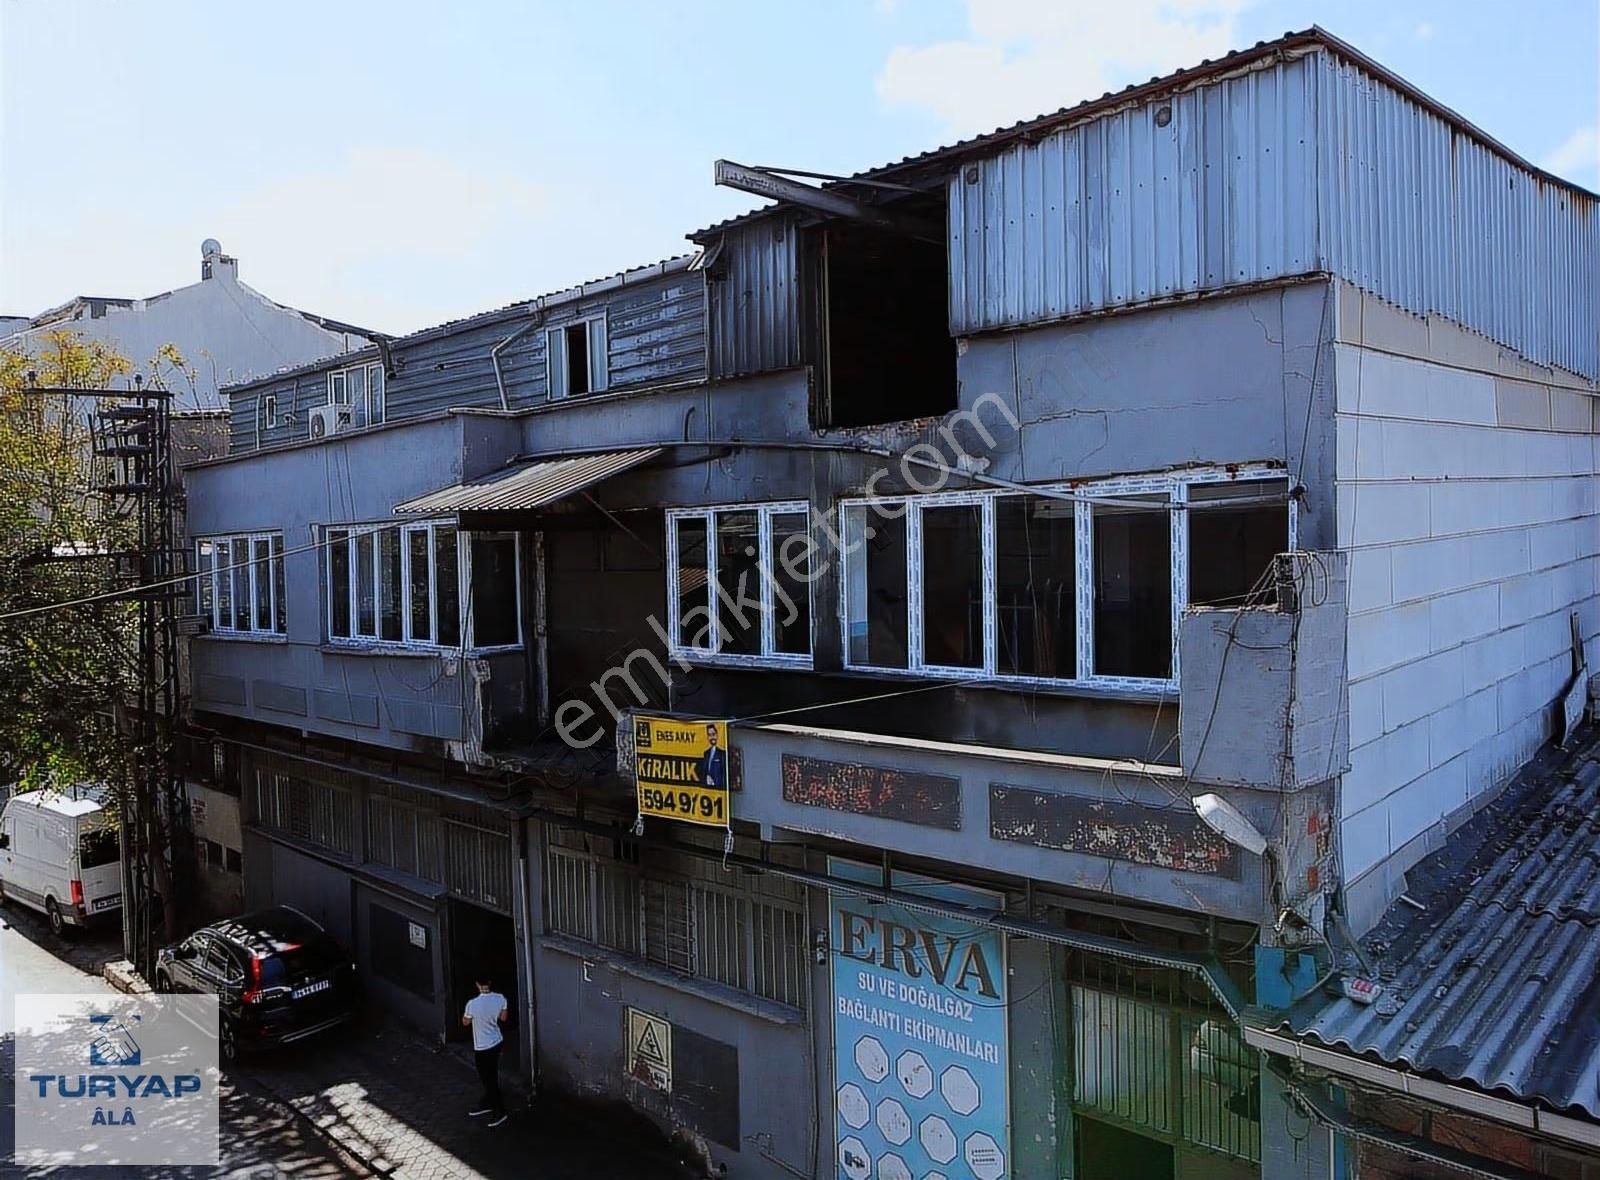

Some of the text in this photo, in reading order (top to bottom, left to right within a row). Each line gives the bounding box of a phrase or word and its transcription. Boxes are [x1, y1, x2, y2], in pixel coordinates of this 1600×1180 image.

[675, 731, 696, 744] AKAY
[644, 789, 676, 811] 594
[838, 909, 1000, 1000] ERVA
[858, 971, 973, 1023] SU VE DOĞALGAZ
[838, 997, 999, 1064] BAĞLANTI EKİPMANLARI
